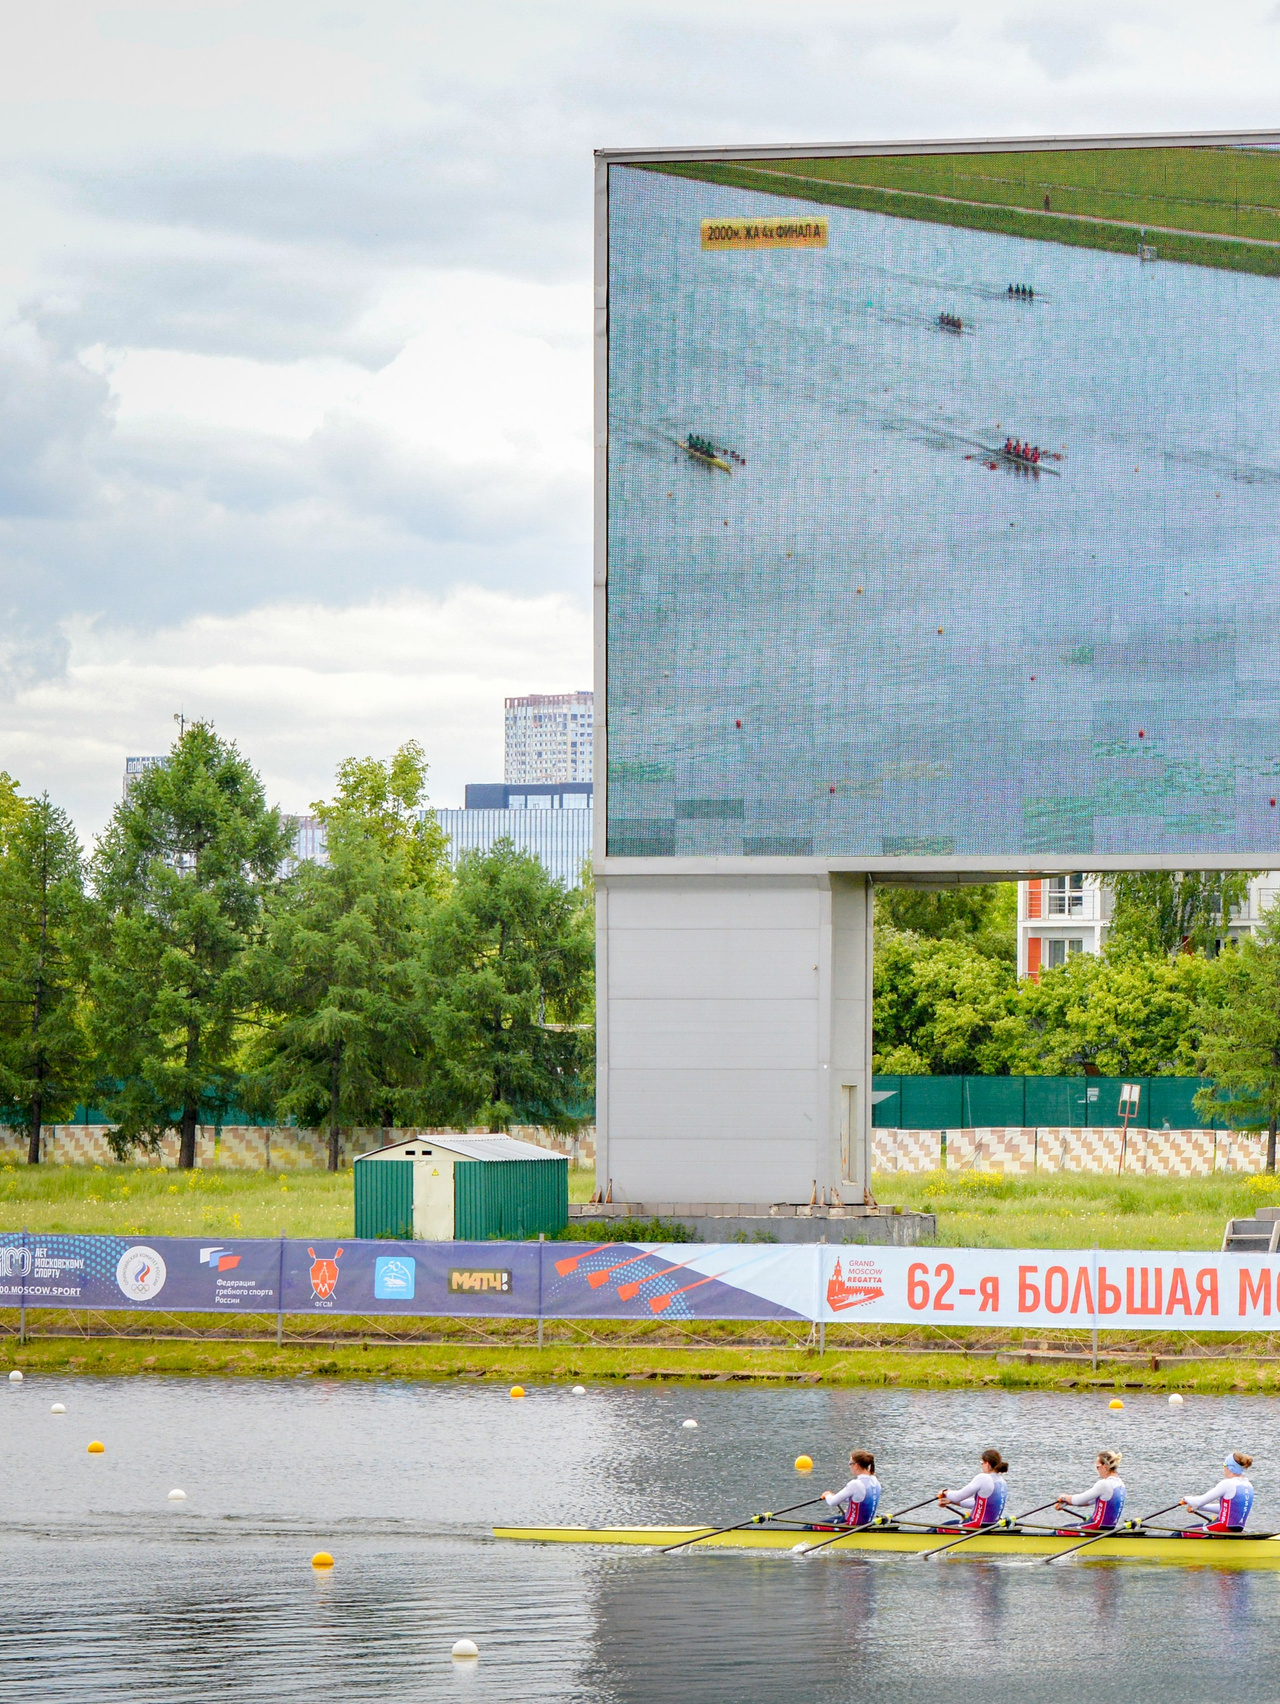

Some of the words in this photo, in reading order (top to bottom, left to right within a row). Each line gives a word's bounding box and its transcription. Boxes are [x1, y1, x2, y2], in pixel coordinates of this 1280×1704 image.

[35, 1248, 47, 1257] ЛЕТ
[34, 1258, 84, 1269] МОСКОВСКОМУ
[34, 1268, 61, 1278] СПОРТУ
[848, 1268, 883, 1276] MOSCOW
[216, 1279, 256, 1288] Федерация
[452, 1272, 509, 1291] МАТЧ!
[847, 1276, 882, 1284] REGATTA
[215, 1288, 248, 1296] гребного
[249, 1288, 273, 1297] спорта
[907, 1262, 999, 1312] 62-я
[1018, 1265, 1219, 1316] БОЛЬШАЯ
[215, 1296, 240, 1304] России
[1239, 1488, 1250, 1524] RUSSIA
